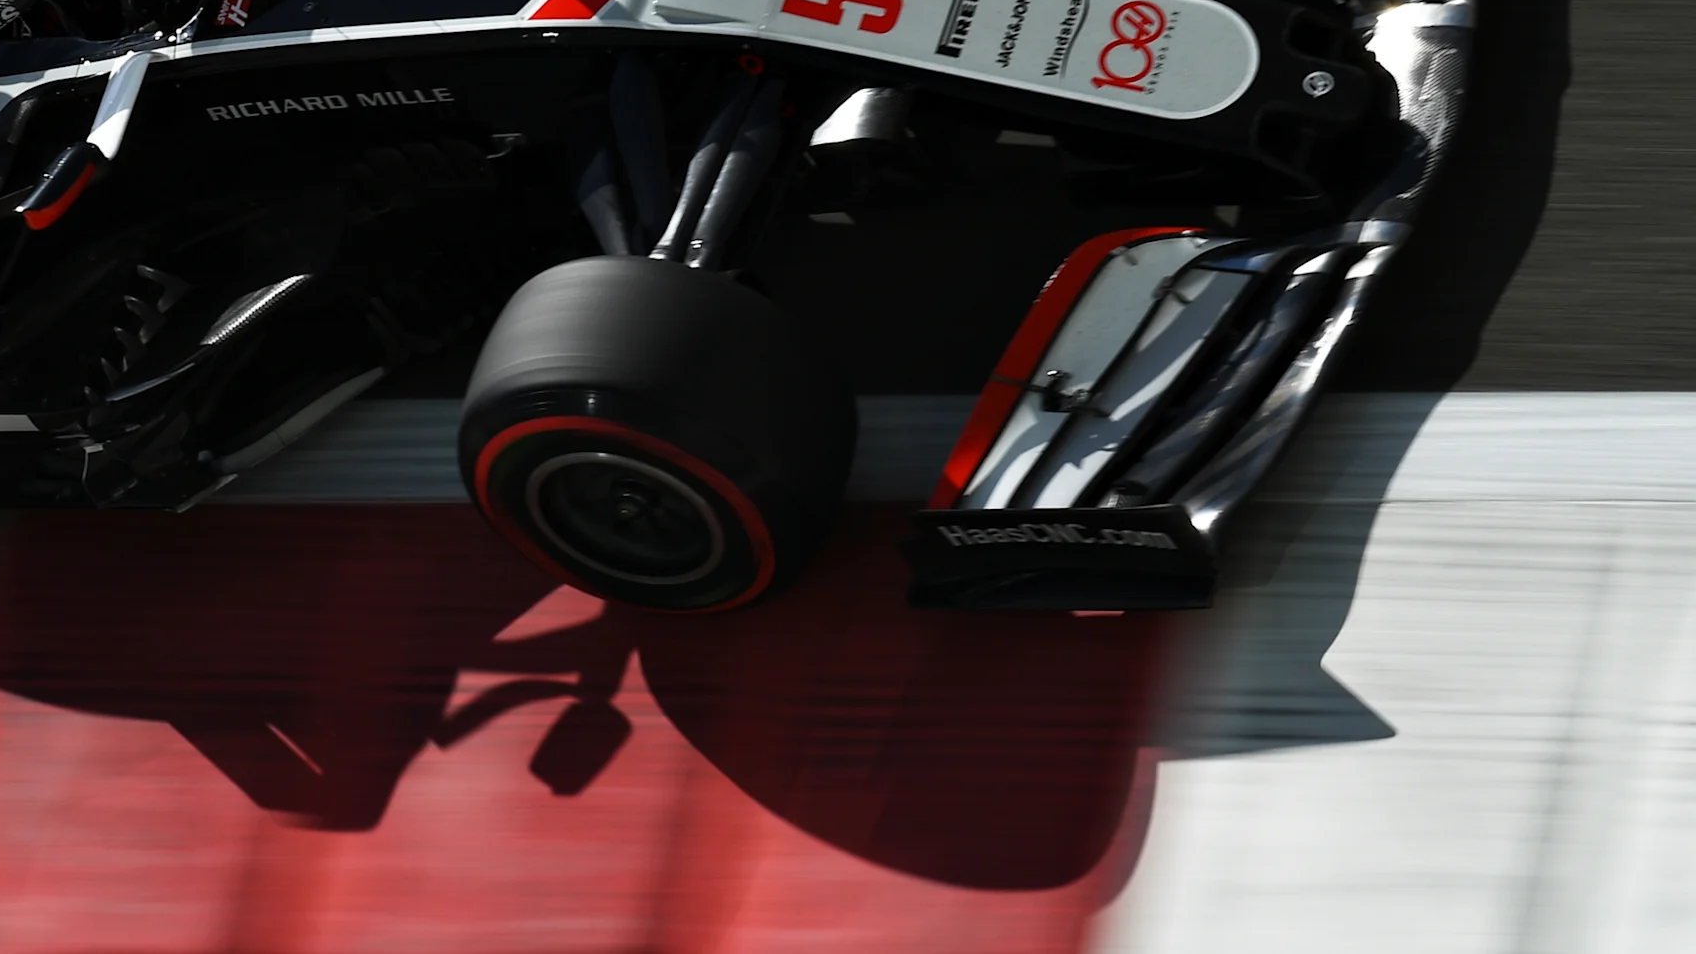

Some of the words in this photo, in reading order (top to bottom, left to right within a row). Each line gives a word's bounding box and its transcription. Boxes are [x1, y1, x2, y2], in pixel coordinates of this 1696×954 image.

[206, 95, 349, 121] RICHARD
[356, 88, 454, 107] MILLE
[937, 523, 1179, 550] HaasCNC.com
